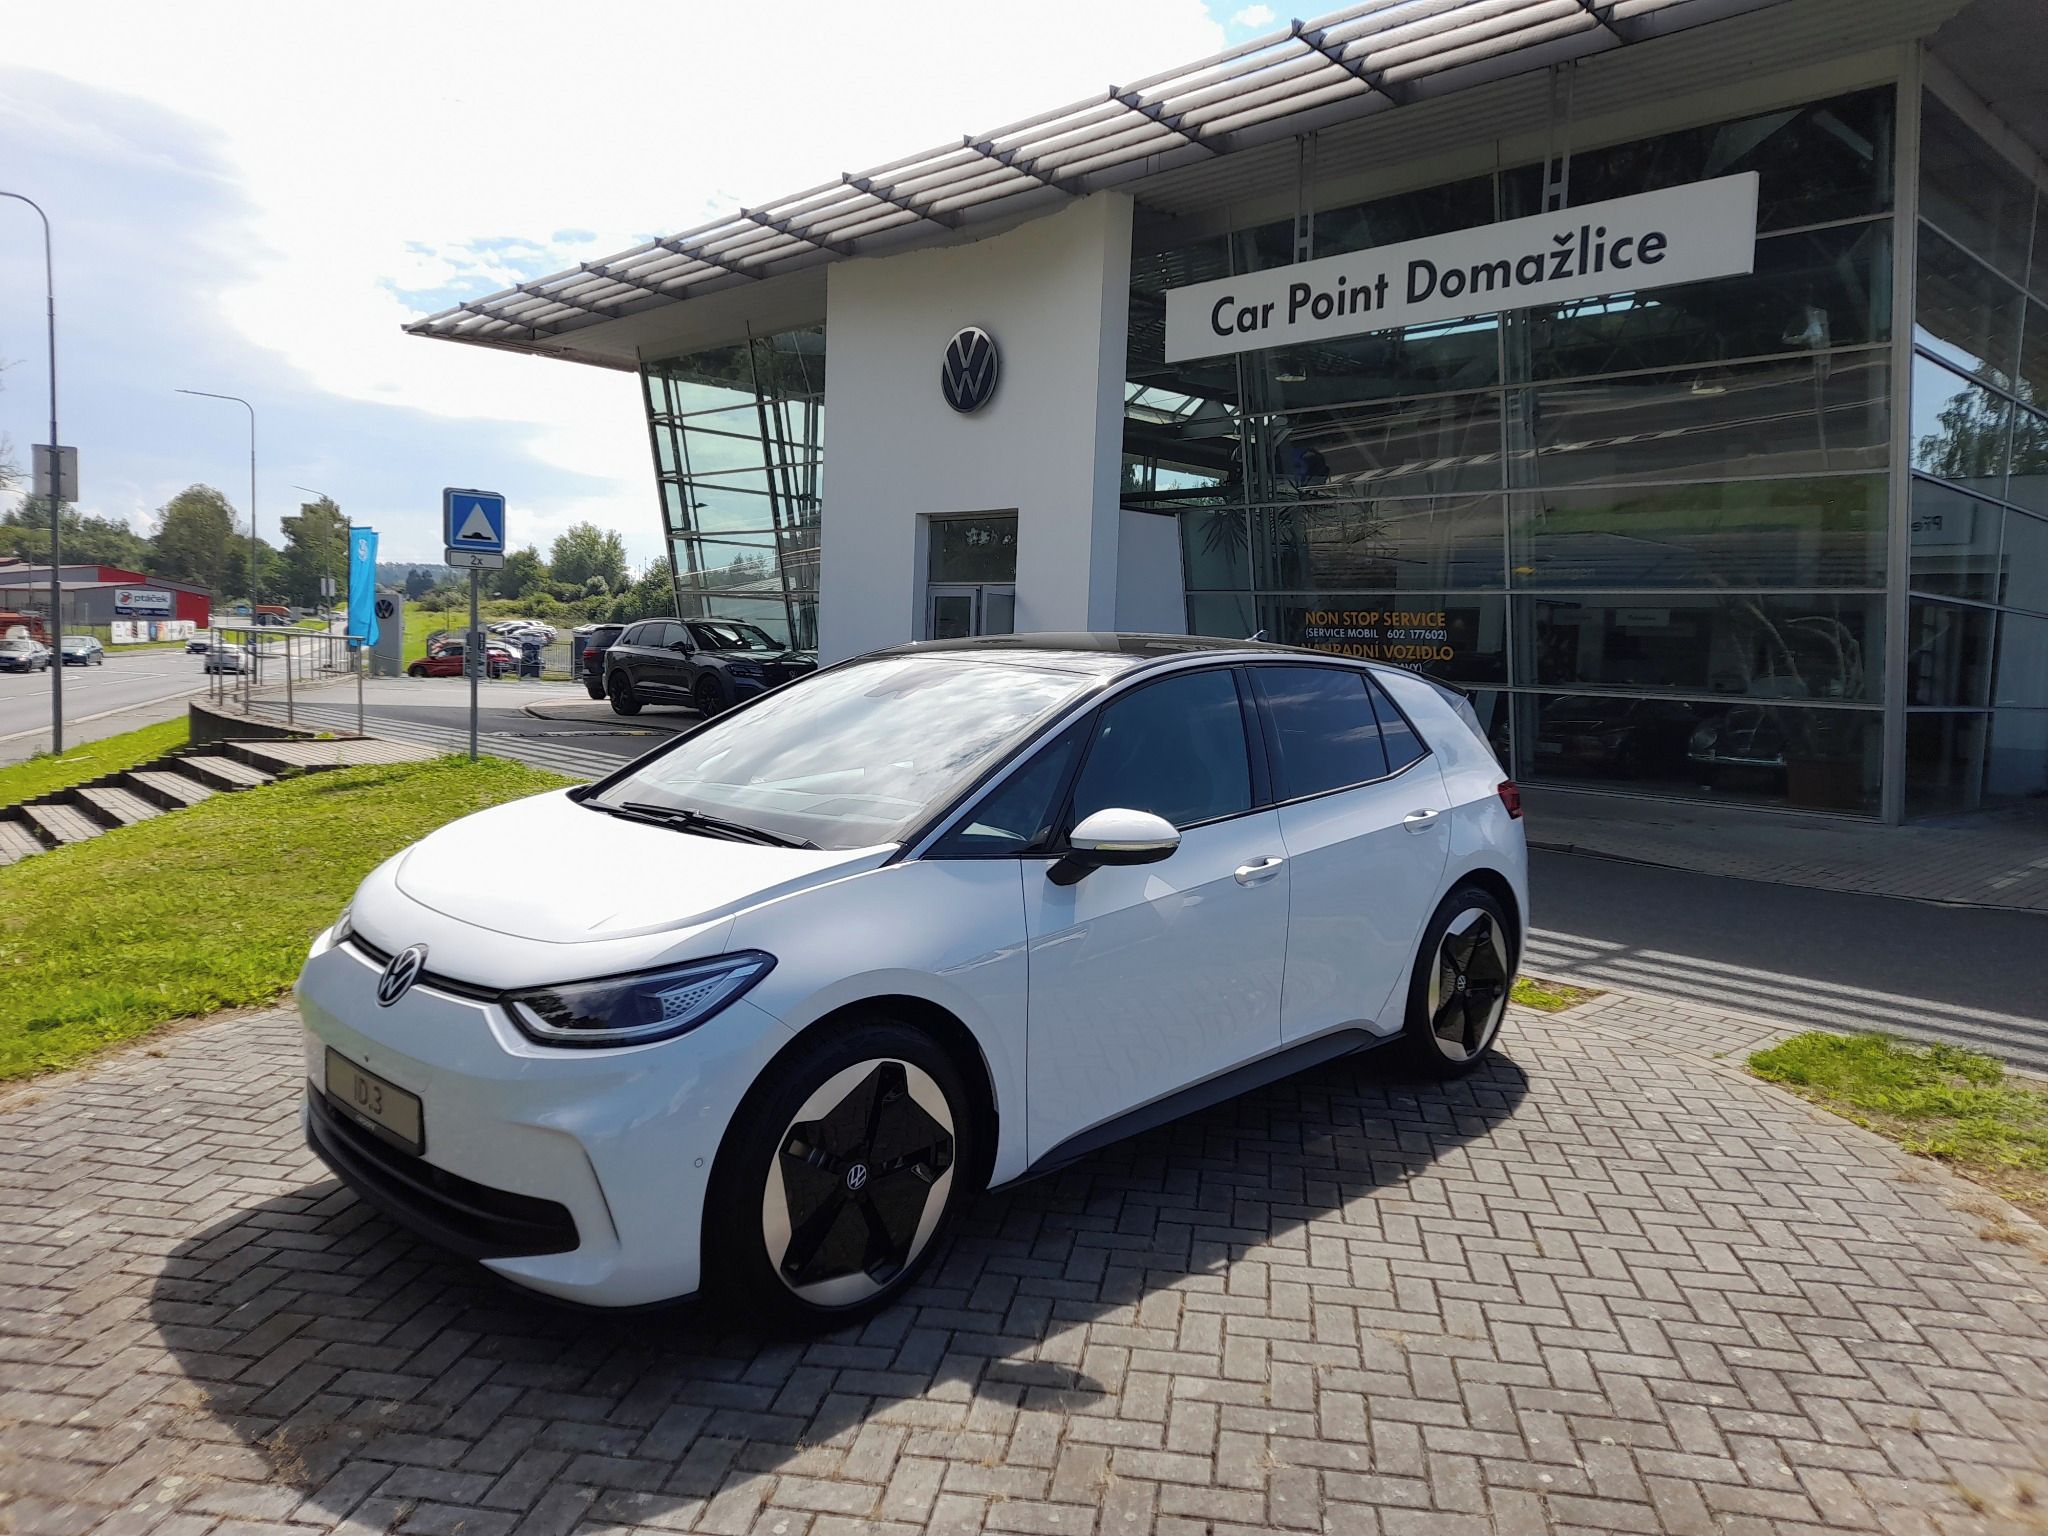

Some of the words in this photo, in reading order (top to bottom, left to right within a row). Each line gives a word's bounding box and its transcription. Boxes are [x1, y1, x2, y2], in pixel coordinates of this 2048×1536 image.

[1211, 296, 1275, 337] Car
[1288, 272, 1389, 325] Point
[1406, 223, 1668, 304] Domažlice
[470, 554, 484, 566] 2x
[1305, 611, 1339, 626] NON
[1342, 611, 1379, 626] STOP
[1383, 612, 1446, 627] SERVICE
[1305, 628, 1345, 639] (SERVICE
[1347, 628, 1379, 638] MOBIL
[1387, 629, 1406, 639] 602
[1409, 629, 1448, 641] 177602)
[1383, 645, 1454, 661] VOZIDLO
